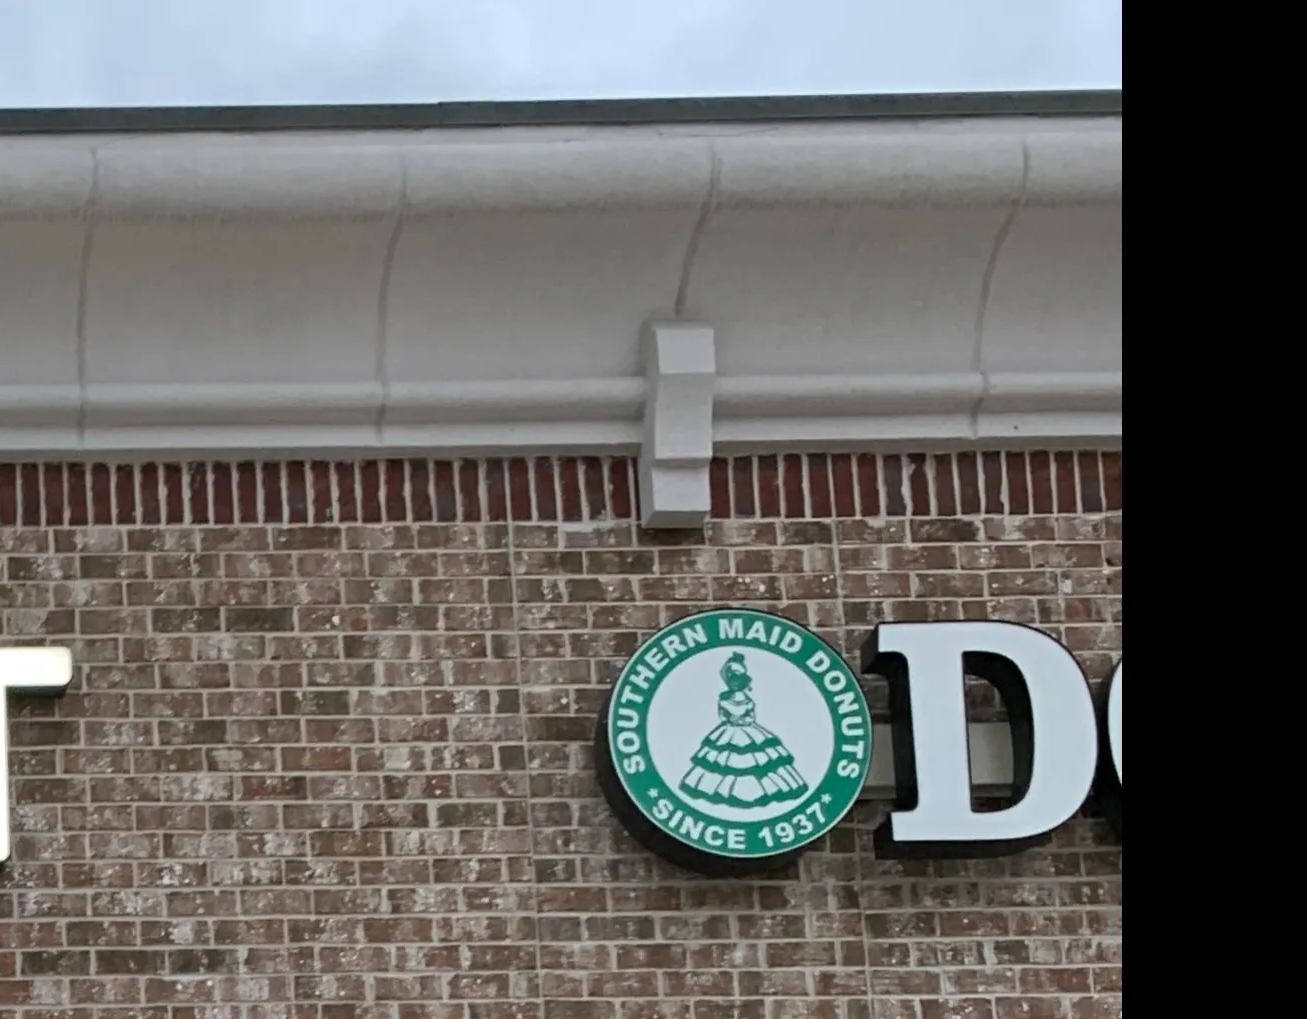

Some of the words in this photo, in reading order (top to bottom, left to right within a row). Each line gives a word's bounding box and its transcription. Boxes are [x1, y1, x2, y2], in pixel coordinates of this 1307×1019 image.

[616, 623, 708, 775] SOUTHERN
[717, 618, 803, 654] MAID
[805, 650, 865, 780] DONUTS
[878, 622, 1122, 841] D
[651, 798, 747, 850] SINCE
[757, 801, 827, 848] 1937
